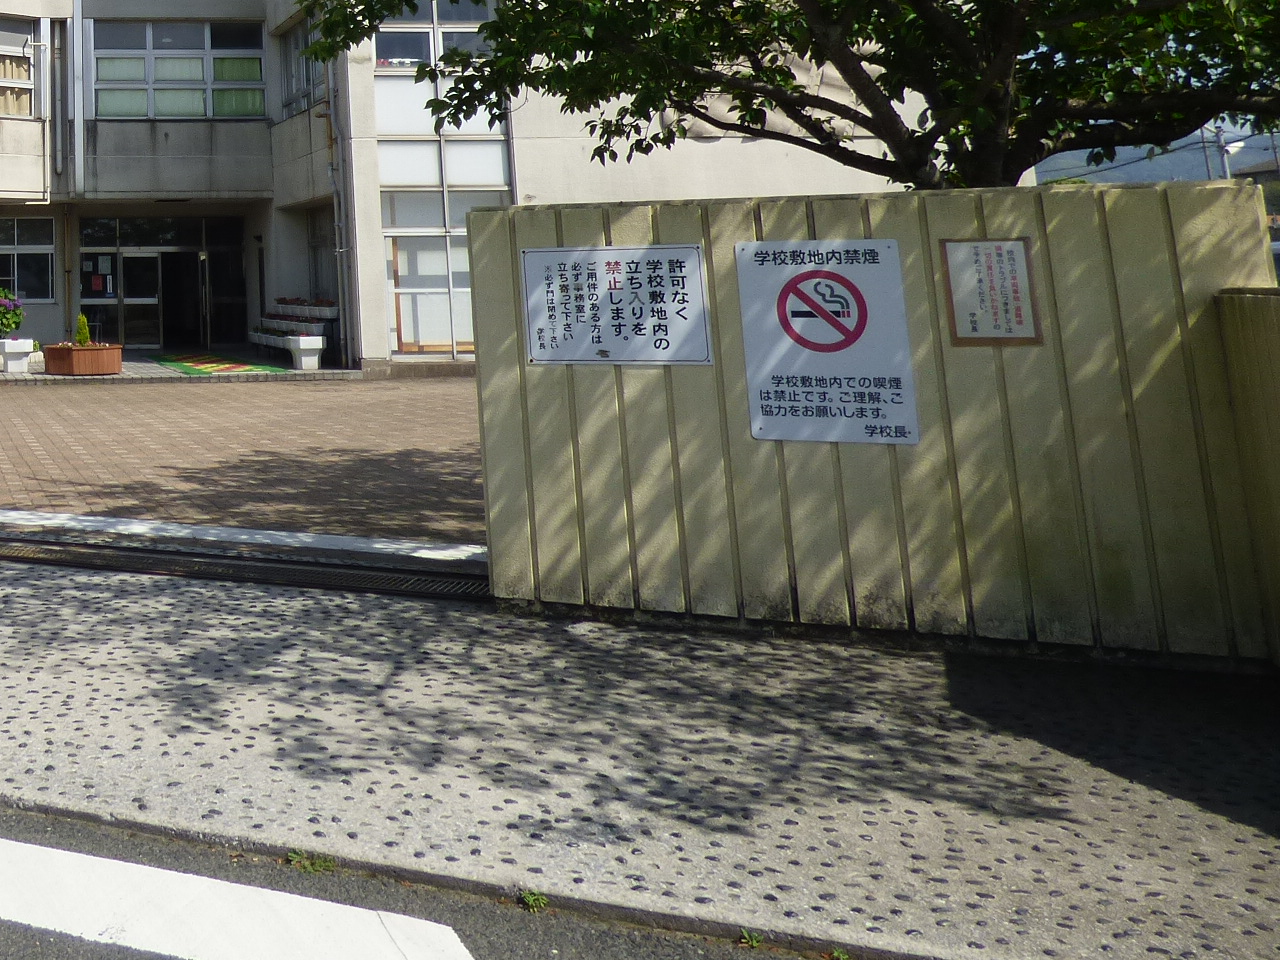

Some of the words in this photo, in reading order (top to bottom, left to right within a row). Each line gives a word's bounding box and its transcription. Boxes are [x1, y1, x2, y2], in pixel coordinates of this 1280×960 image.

[753, 248, 880, 266] 学校敷地内禁煙
[557, 262, 573, 341] 立ち寄って下さい
[571, 262, 586, 324] 必ず事務室に
[586, 262, 603, 344] ご用件のある方は
[604, 260, 629, 341] 禁止します。
[625, 260, 647, 336] 立ち入りを
[646, 259, 670, 350] 学校敷地内の
[667, 258, 689, 320] 許可なく
[536, 327, 546, 350] 学校長
[969, 312, 978, 333] 学校長
[759, 389, 904, 405] は禁止です。ご理解、ご
[771, 374, 902, 390] 学校敷地内での喫煙
[760, 404, 887, 420] 協力をお願いします。
[864, 424, 908, 439] 学校長
